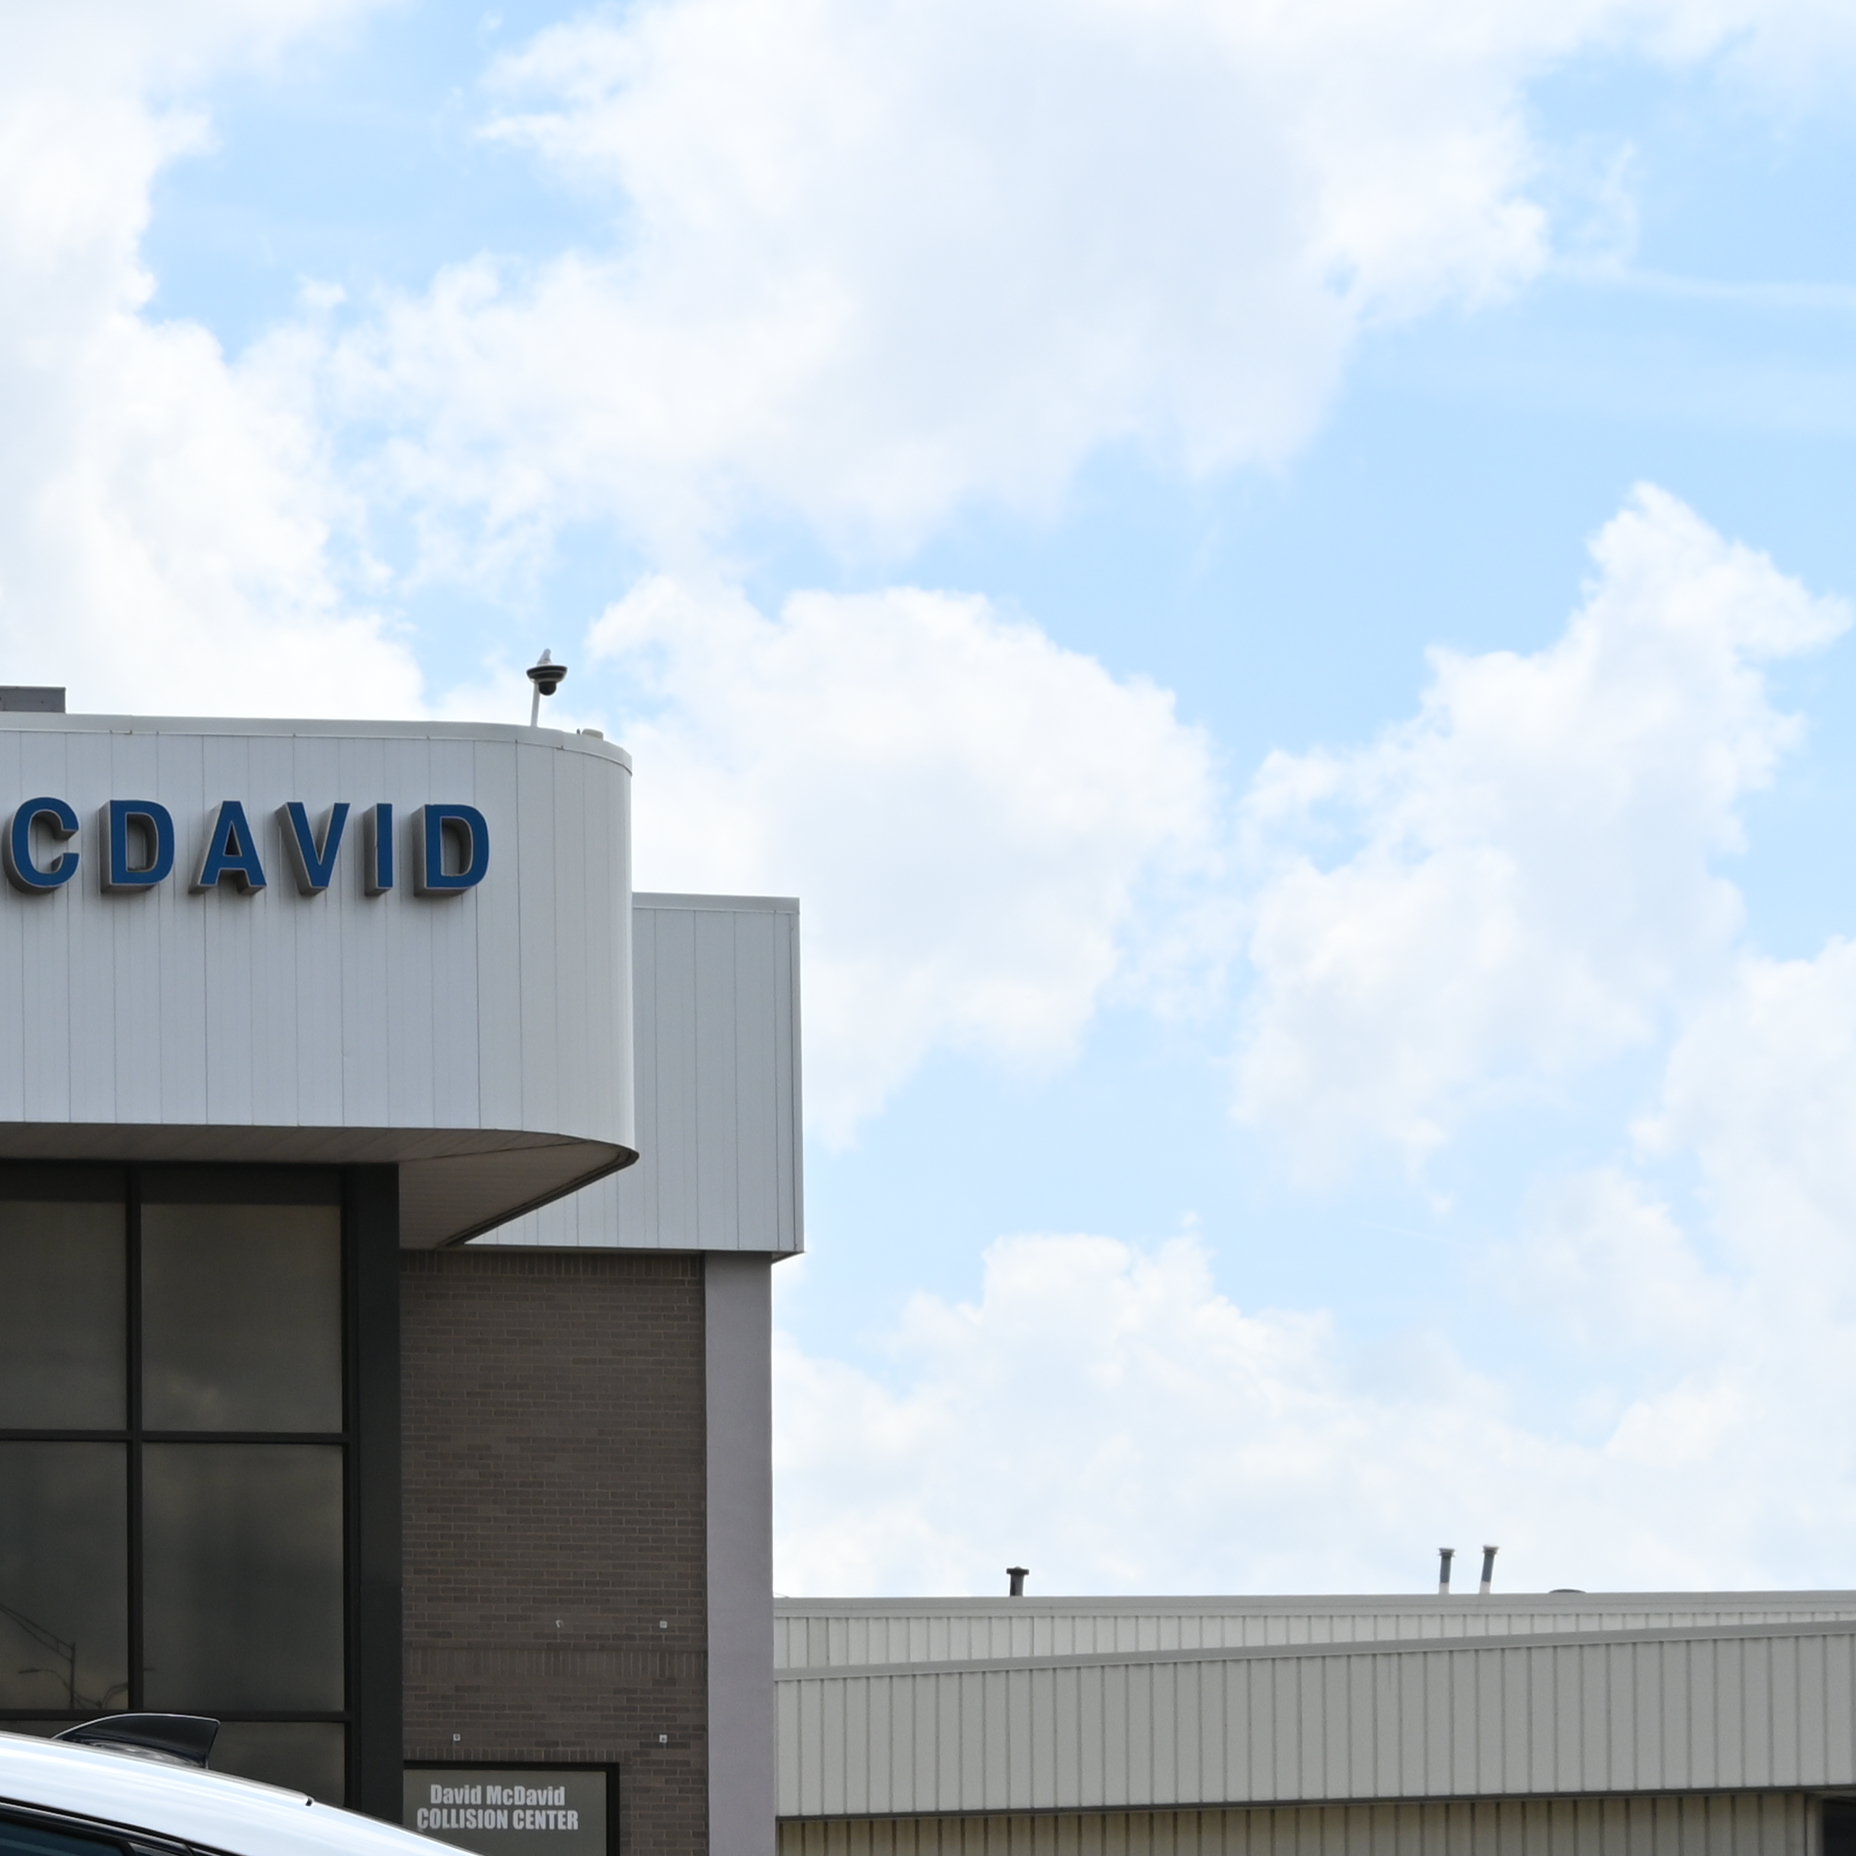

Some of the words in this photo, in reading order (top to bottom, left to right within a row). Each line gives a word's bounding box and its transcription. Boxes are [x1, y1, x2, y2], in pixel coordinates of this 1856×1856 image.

[430, 1784, 482, 1806] David
[485, 1785, 566, 1807] McDavid
[416, 1808, 509, 1831] COLLISION
[512, 1809, 579, 1831] CENTER
